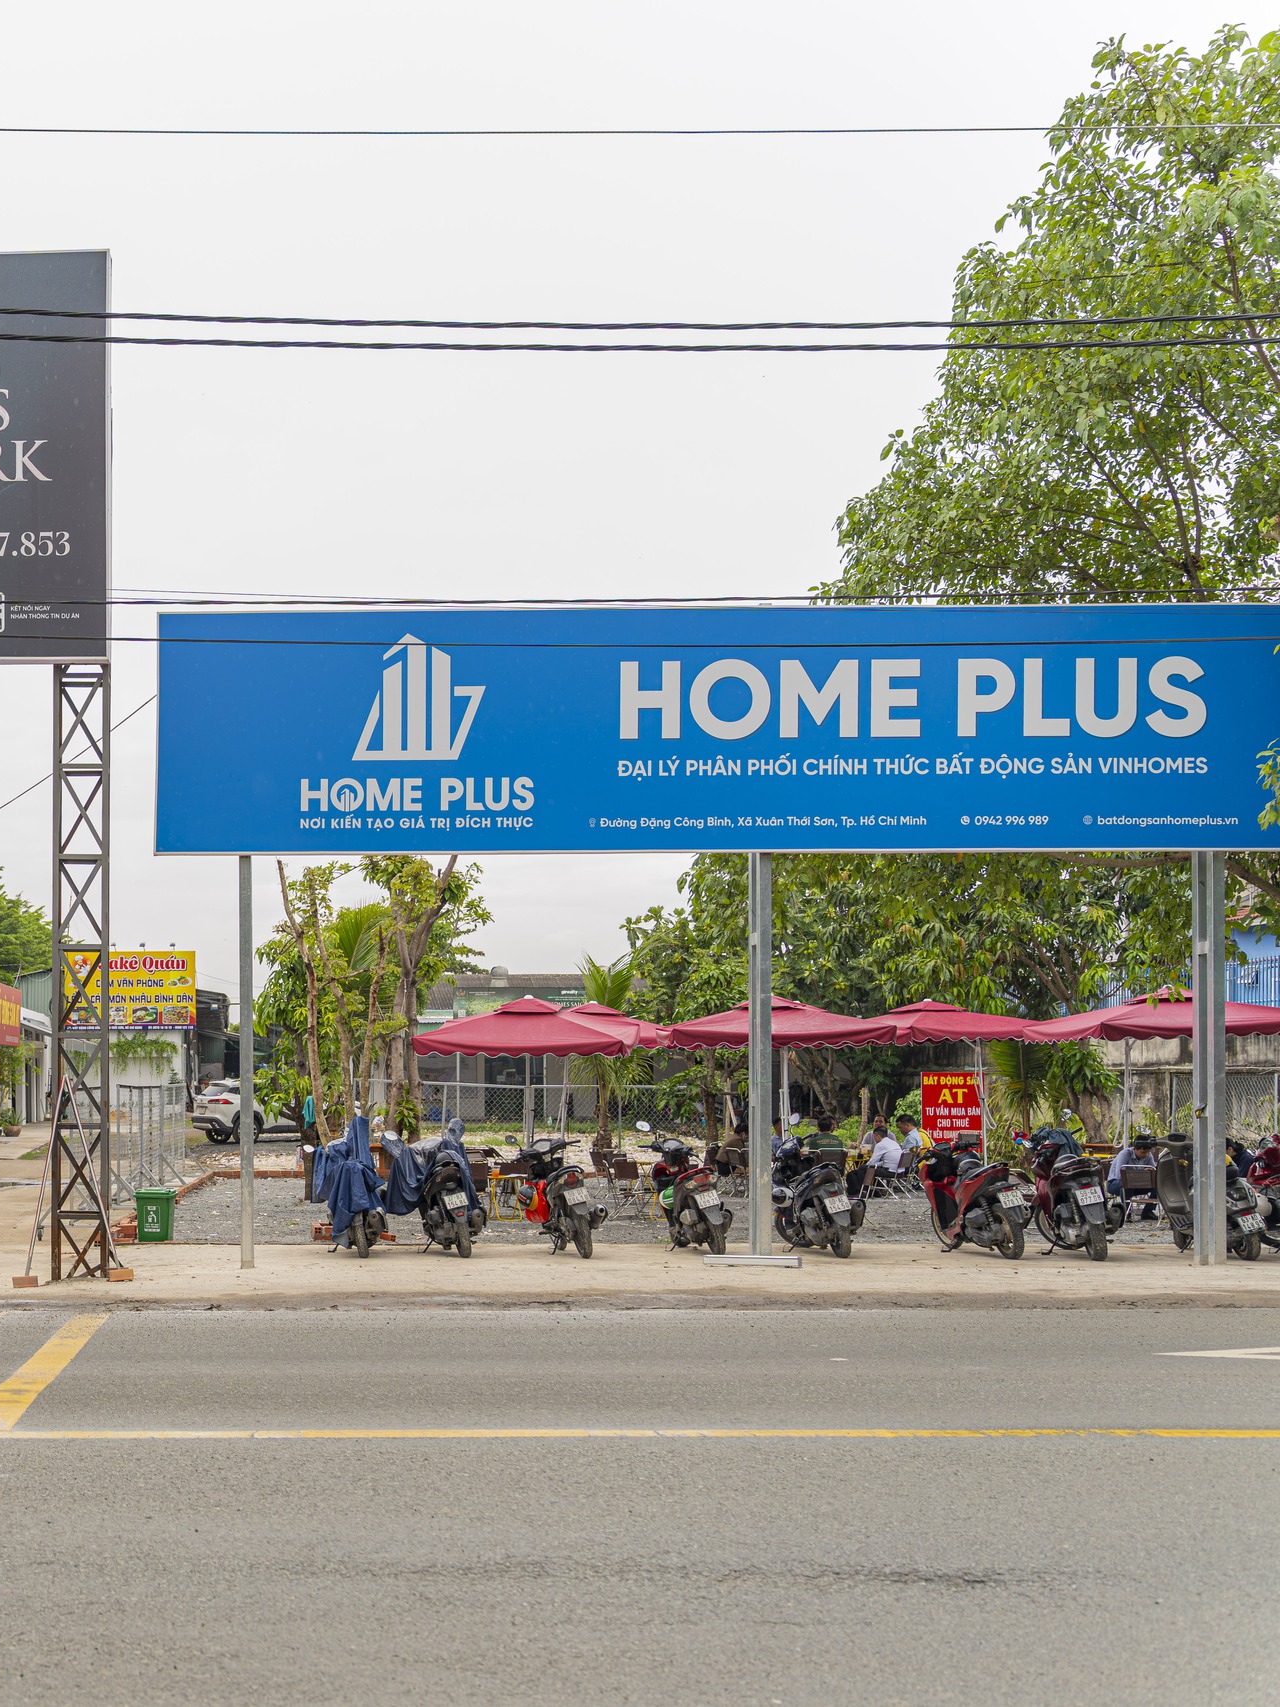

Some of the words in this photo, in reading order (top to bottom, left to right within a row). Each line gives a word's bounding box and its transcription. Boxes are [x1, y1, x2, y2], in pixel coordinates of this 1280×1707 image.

[619, 658, 921, 740] HOME
[957, 655, 1207, 738] PLUS
[617, 760, 652, 782] ĐẠI
[658, 755, 681, 776] LÝ
[686, 755, 741, 776] PHÂN
[747, 753, 797, 776] PHỐI
[803, 754, 868, 776] CHÍNH
[873, 754, 930, 775] THỨC
[936, 751, 974, 775] BẤT
[979, 753, 1045, 779] ĐỘNG
[1050, 752, 1092, 774] SẢN
[1098, 756, 1209, 774] VINHOMES
[300, 777, 423, 813] HOME
[440, 776, 535, 811] PLUS
[300, 816, 326, 829] NƠI
[331, 814, 362, 829] KIẾN
[366, 817, 395, 832] TẠO
[399, 815, 425, 829] GIÁ
[430, 817, 450, 832] TRỊ
[455, 814, 491, 828] ĐÍCH
[496, 816, 534, 831] THỰC
[600, 817, 637, 830] Đường
[640, 817, 671, 830] Đặng
[674, 817, 704, 829] Công
[737, 816, 753, 827] Xã
[755, 816, 784, 827] Xuân
[787, 816, 811, 827] Thới
[813, 816, 838, 828] Sơn,
[841, 816, 857, 828] Tp.
[860, 815, 875, 826] Hồ
[878, 815, 897, 826] Chí
[900, 815, 927, 826] Minh
[974, 815, 1002, 826] 0942
[1005, 815, 1025, 826] 996
[1028, 815, 1049, 826] 989
[1097, 814, 1239, 828] batdongsanhomeplus.vn
[98, 955, 139, 971] akê
[142, 955, 187, 974] Quán
[136, 977, 164, 988] PHÒNG
[155, 993, 173, 1003] BÌNH
[923, 1074, 938, 1085] BẤT
[940, 1075, 964, 1087] ĐỘNG
[938, 1088, 968, 1104] AT
[925, 1106, 935, 1116] TƯ
[935, 1105, 949, 1116] VẤN
[951, 1107, 965, 1116] MUA
[967, 1106, 980, 1116] BÁN
[937, 1118, 951, 1127] CHO
[952, 1117, 969, 1127] THUÊ
